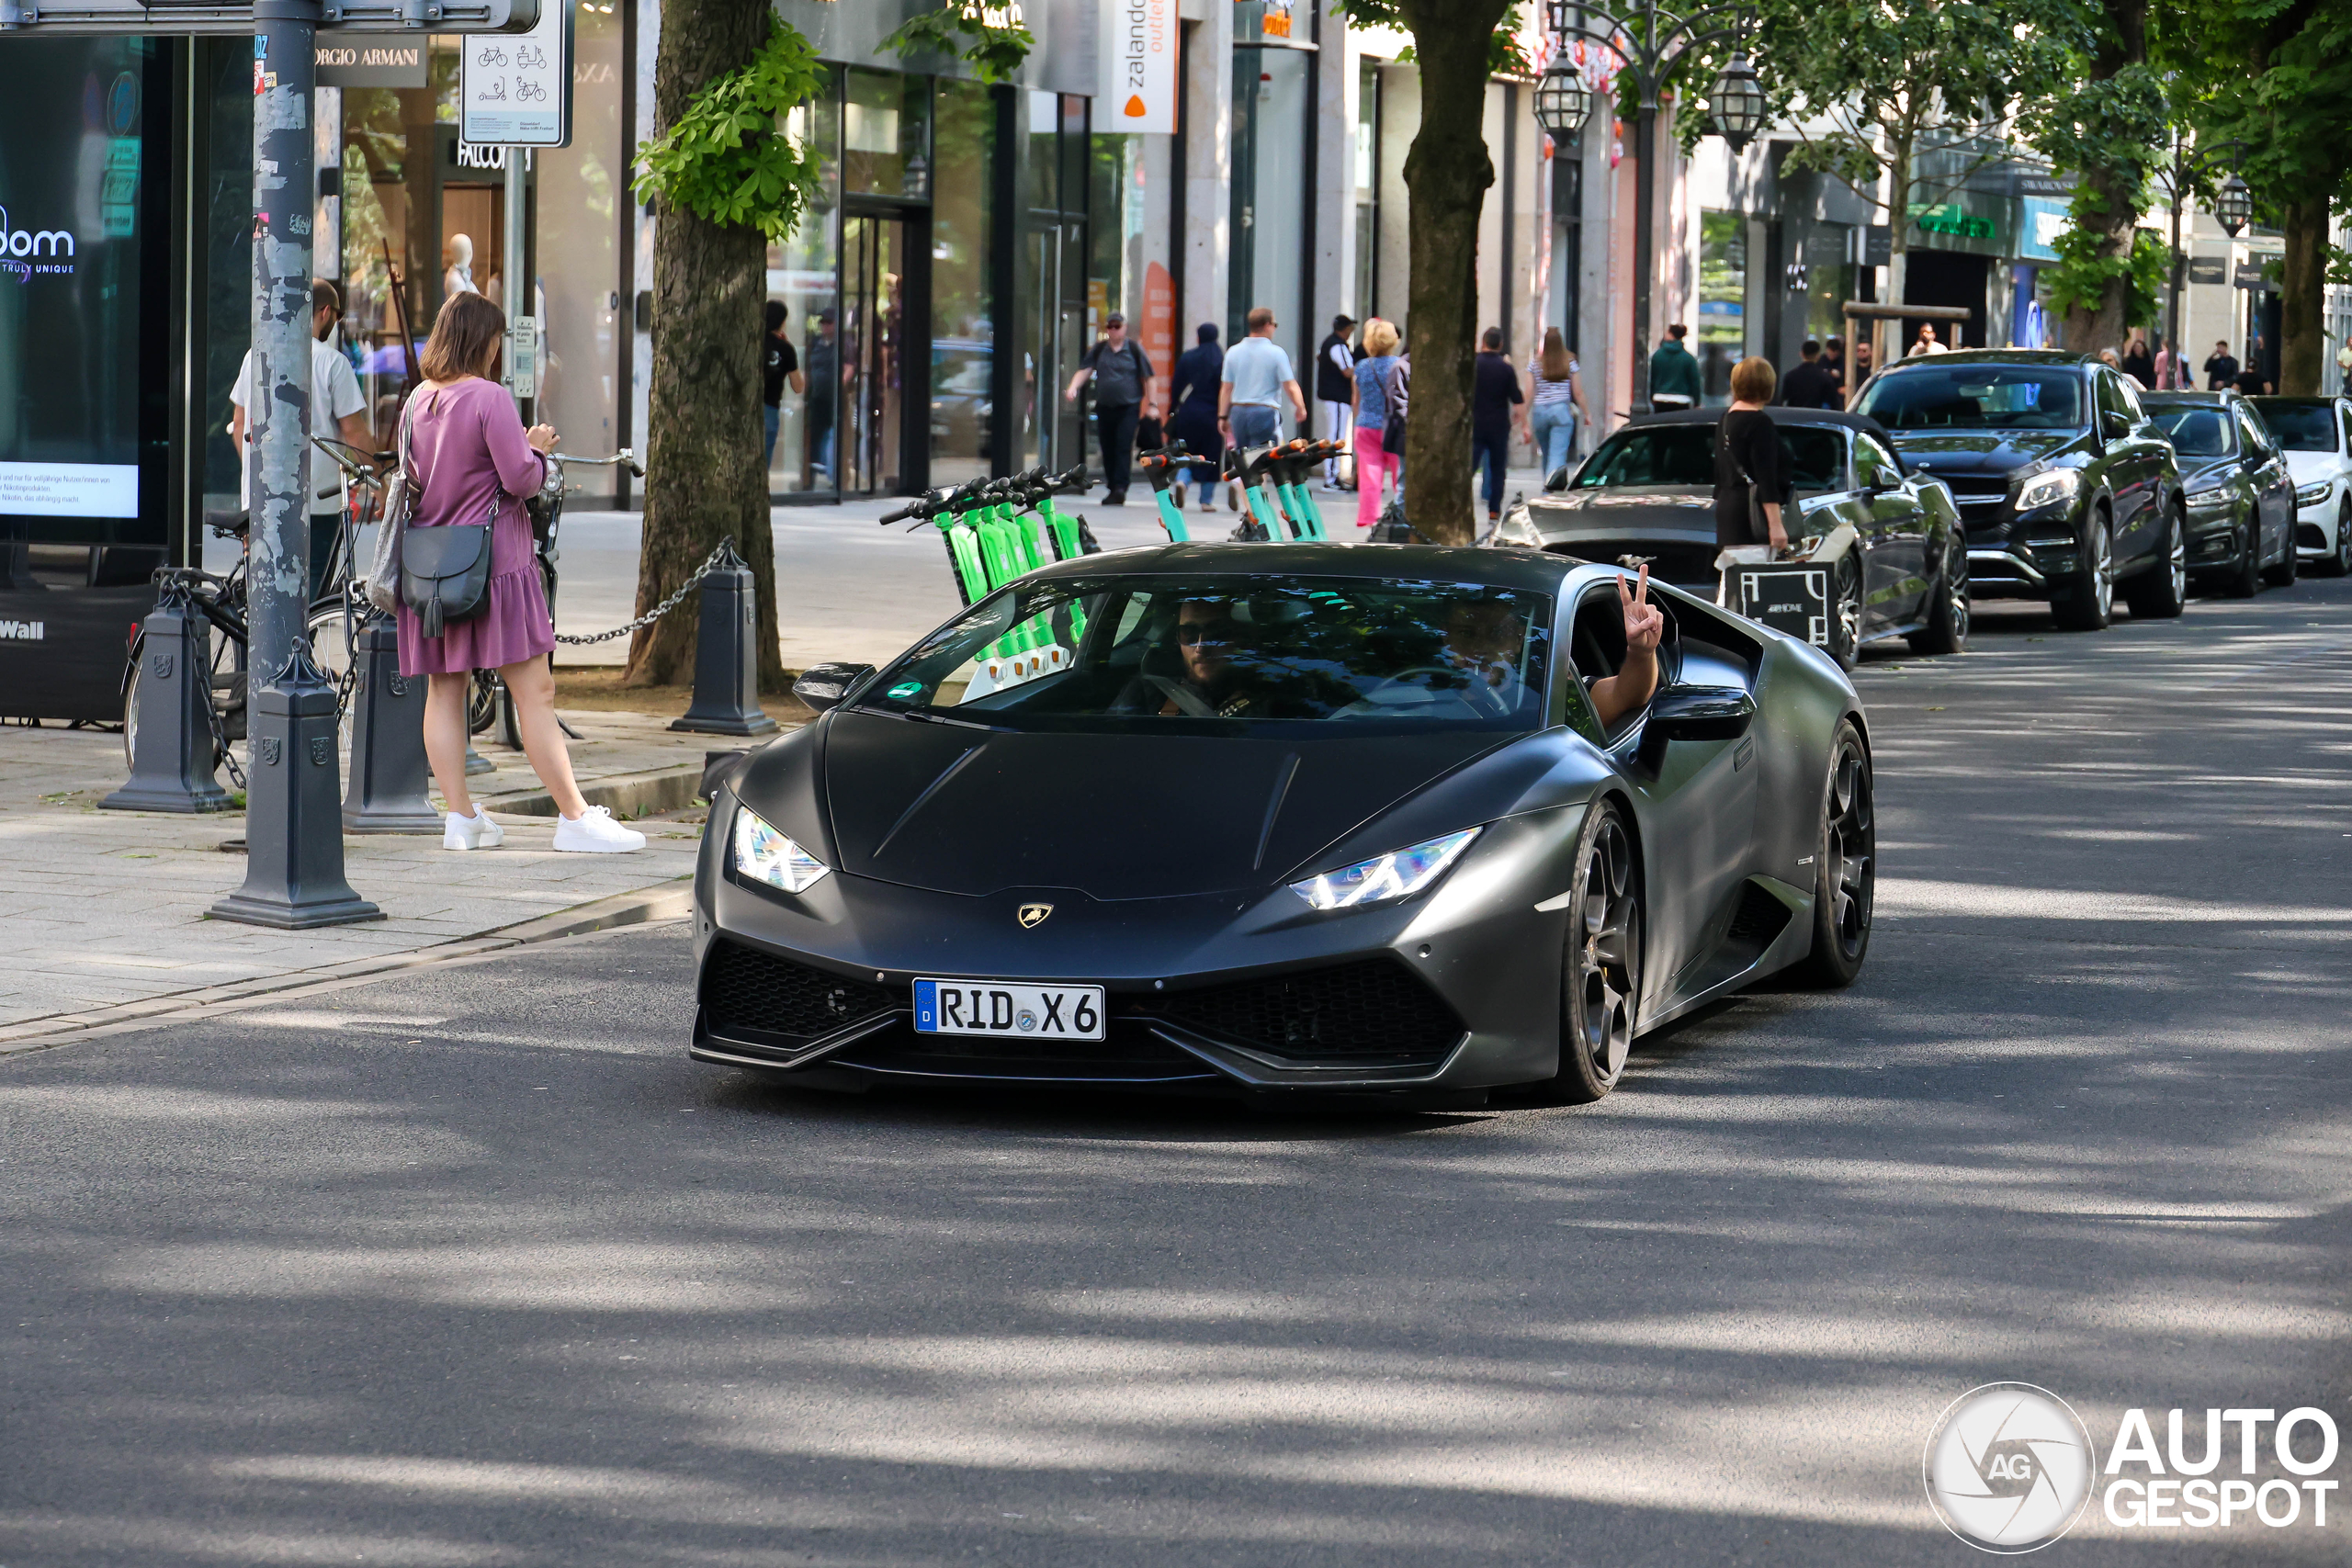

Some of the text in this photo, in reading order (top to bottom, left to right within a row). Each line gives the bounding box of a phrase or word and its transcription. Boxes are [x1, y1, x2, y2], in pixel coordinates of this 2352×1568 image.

[361, 48, 419, 66] ARMANI
[3, 264, 74, 274] TRULY UNIQUE
[0, 620, 44, 640] Wall
[922, 1010, 931, 1022] D
[939, 987, 1013, 1030] RID
